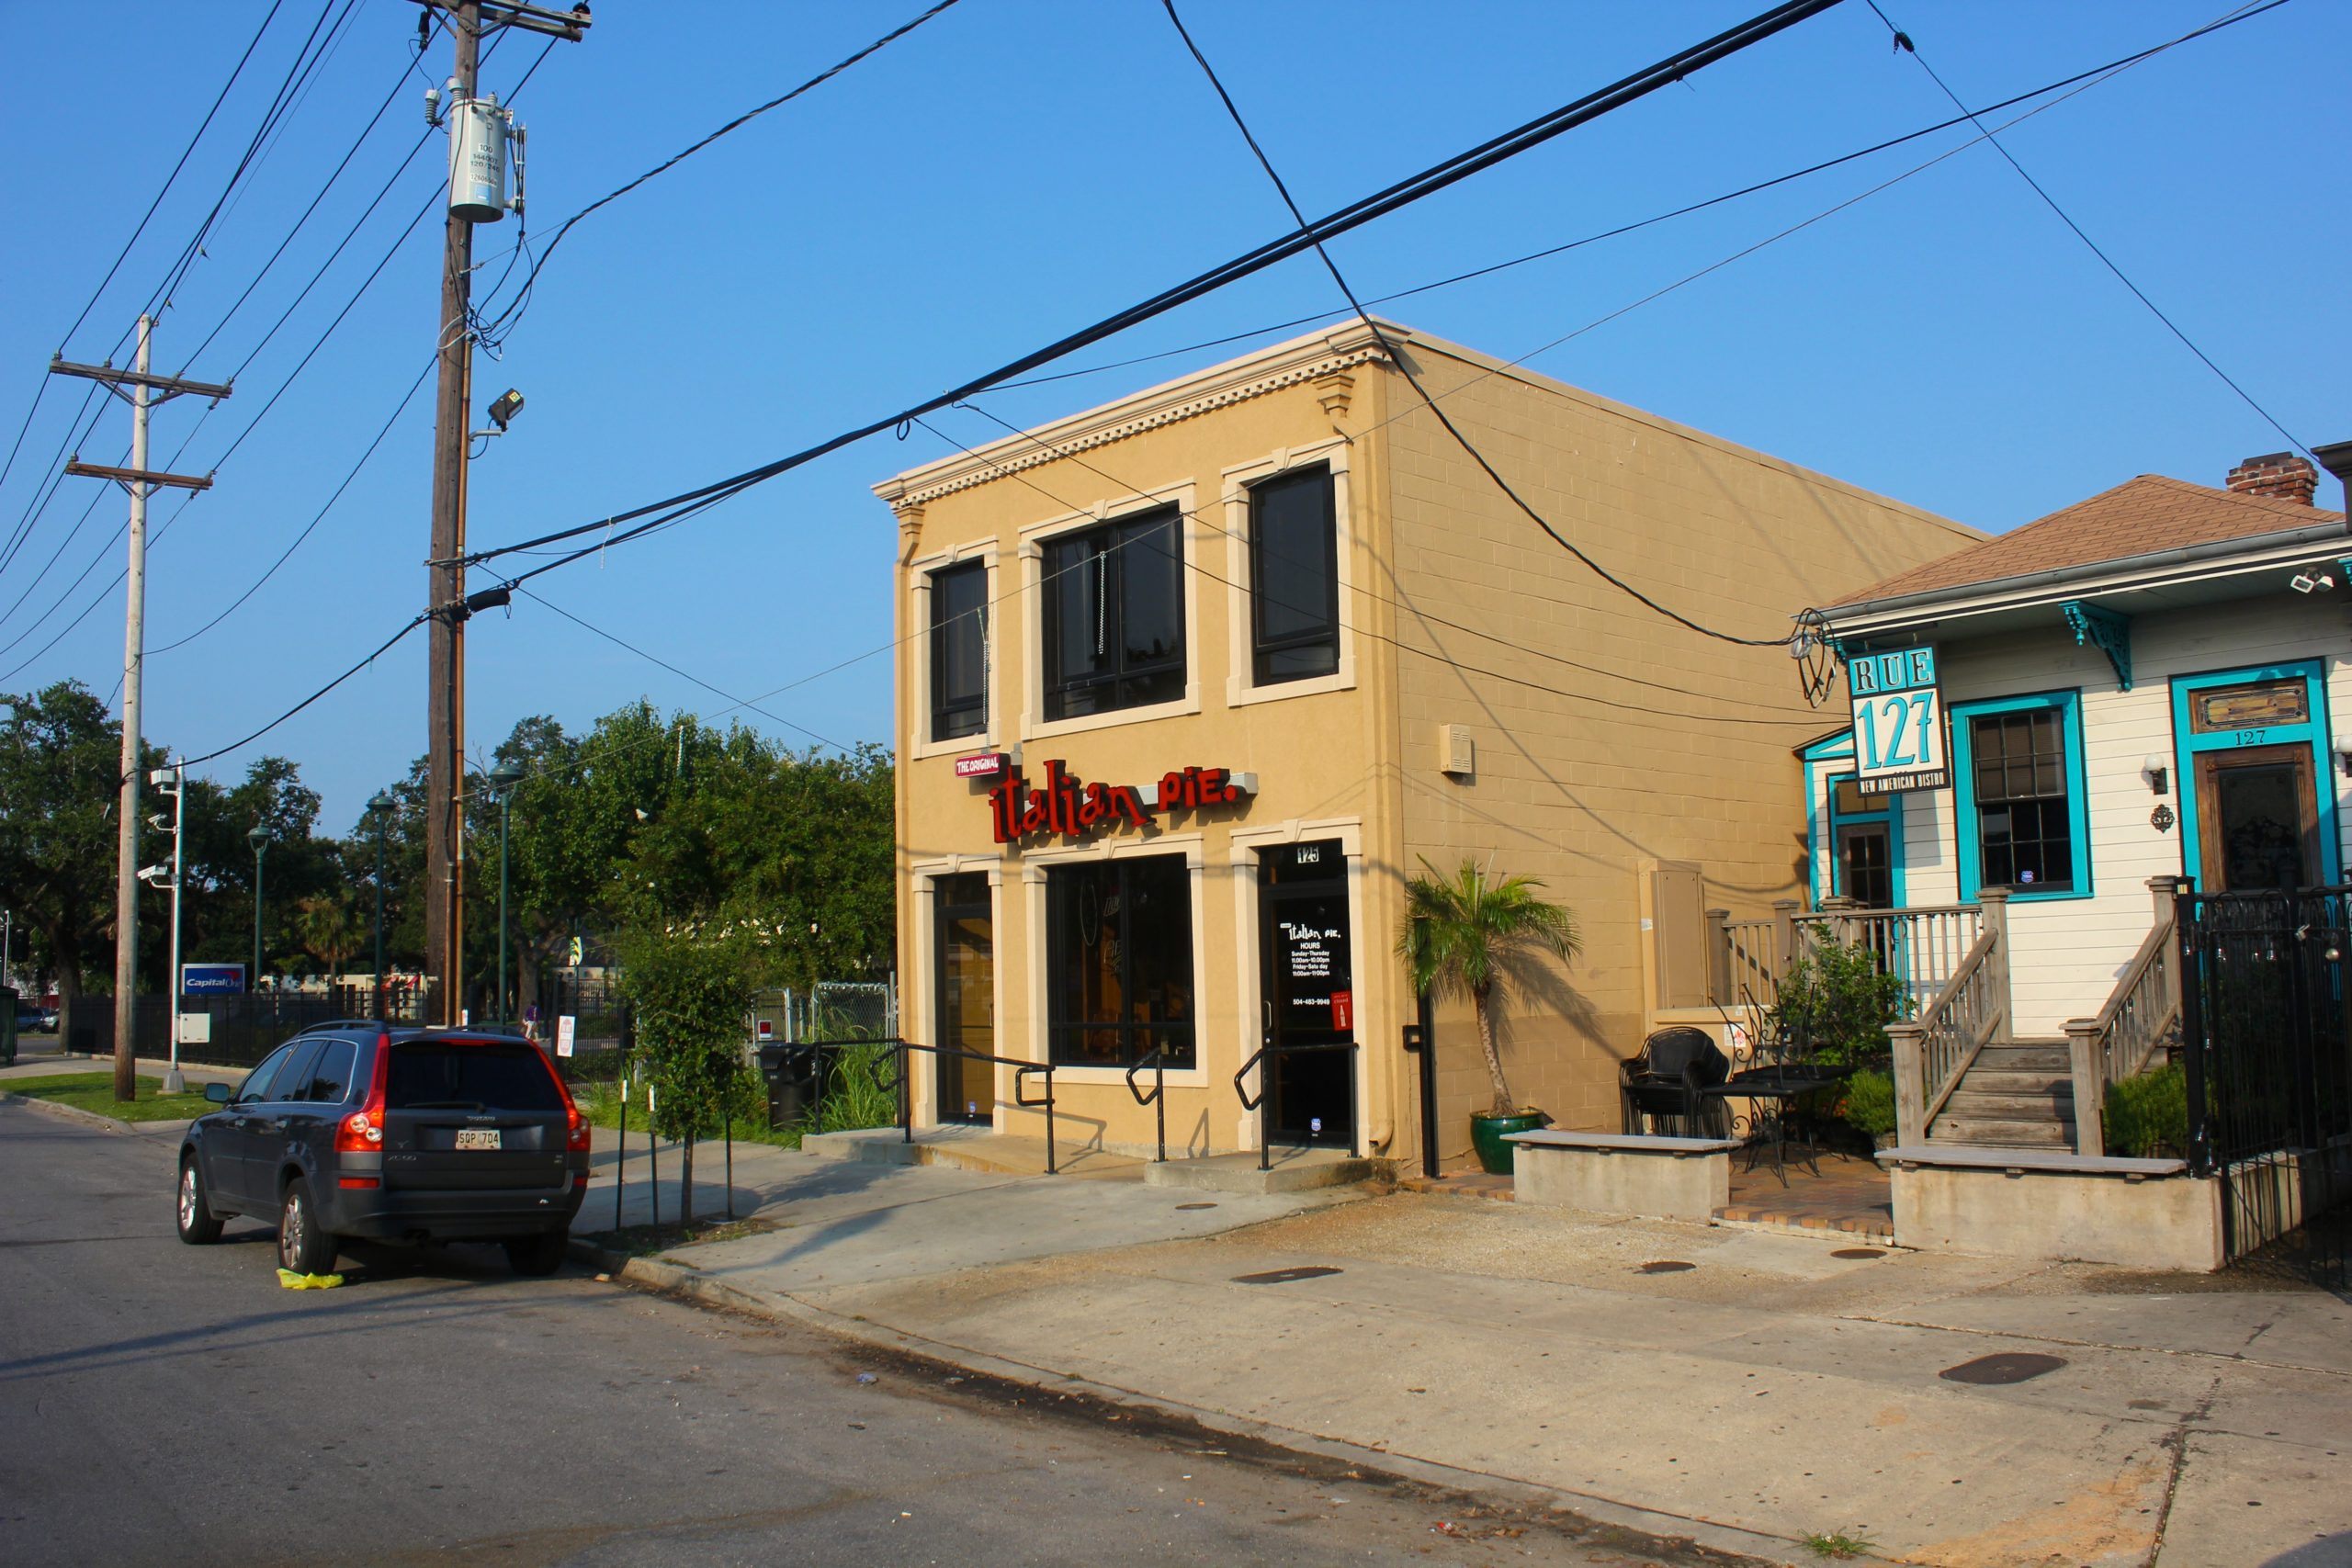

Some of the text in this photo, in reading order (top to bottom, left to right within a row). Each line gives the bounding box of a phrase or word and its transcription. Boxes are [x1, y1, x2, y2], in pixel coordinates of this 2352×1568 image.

[480, 144, 493, 153] 100
[1854, 651, 1930, 691] RUE
[1856, 691, 1934, 771] 127
[2234, 729, 2267, 746] 127
[956, 756, 999, 774] THE ORIGINAL
[1860, 772, 1944, 794] NEW AMERICAN BISTRO
[989, 759, 1148, 843] italian
[1298, 845, 1318, 863] 125
[1300, 942, 1321, 950] HOURS
[459, 1133, 499, 1144] SQP 704
